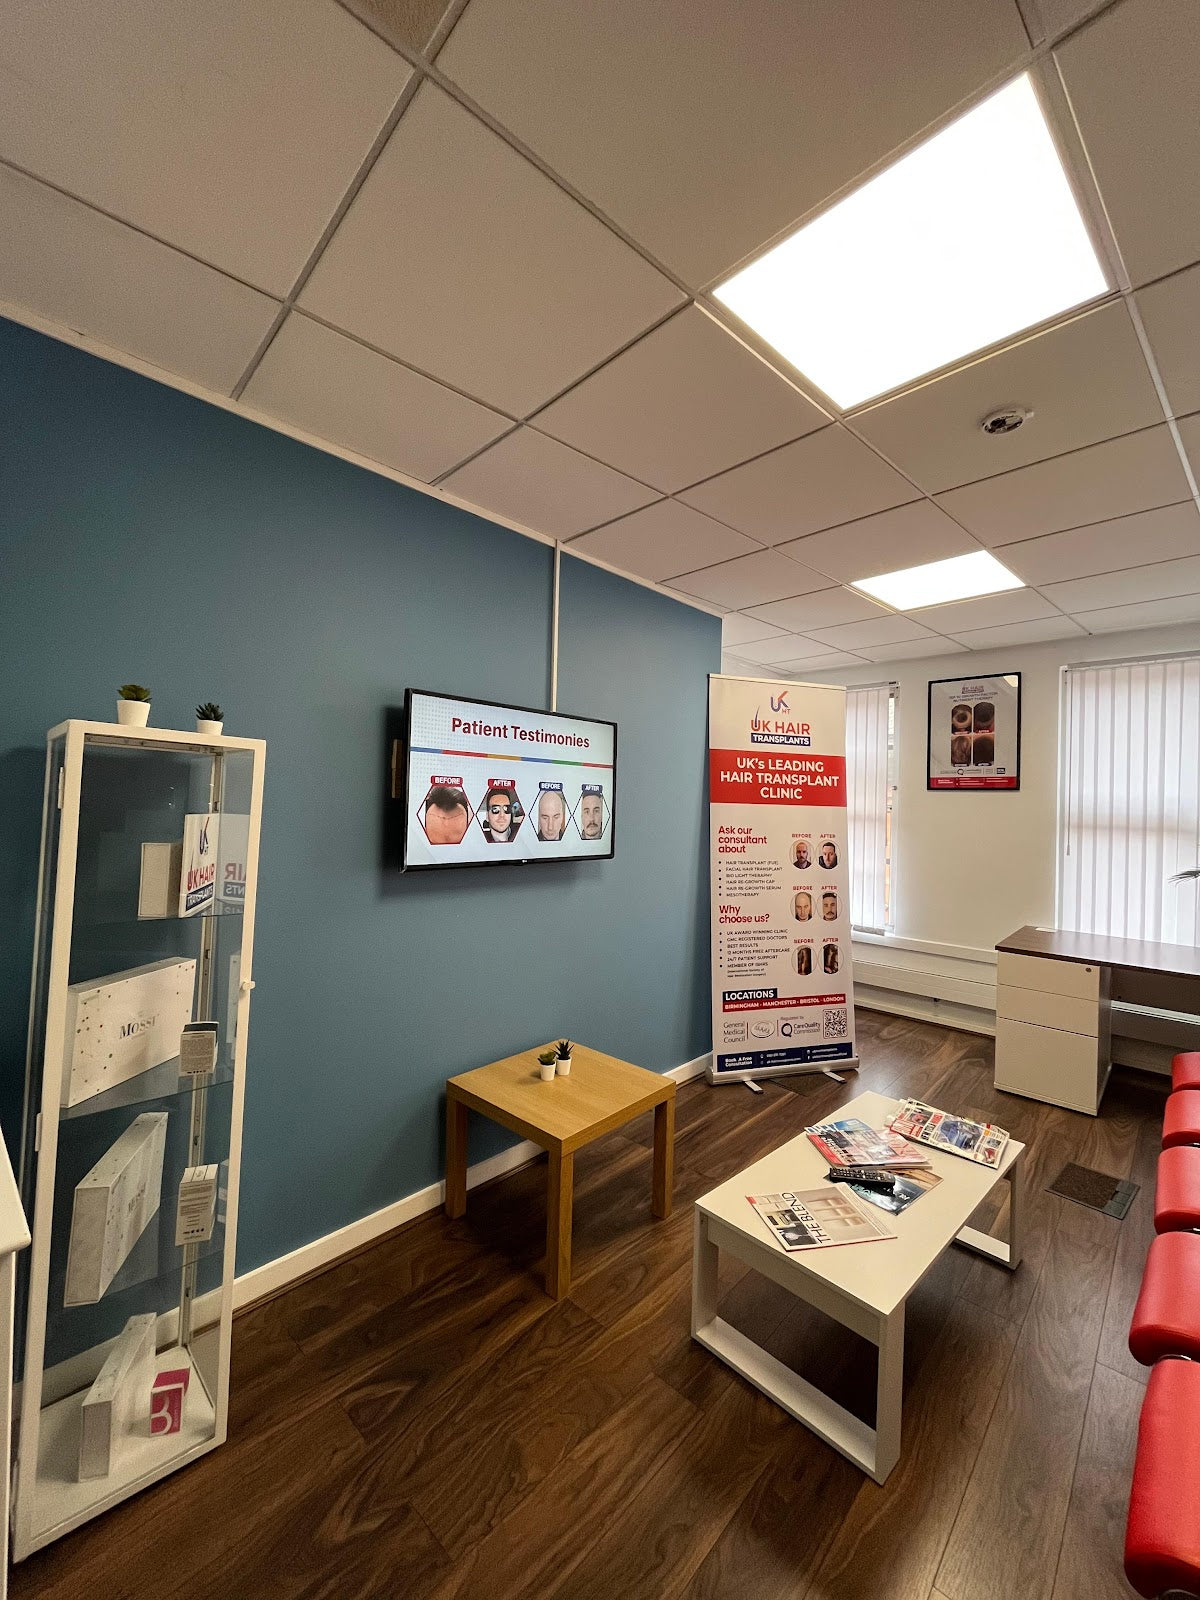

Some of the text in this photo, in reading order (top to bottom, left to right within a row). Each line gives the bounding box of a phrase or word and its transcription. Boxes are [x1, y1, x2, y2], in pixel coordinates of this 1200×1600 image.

[451, 717, 590, 748] Patient Testimonies
[751, 719, 810, 735] UK HAIR
[753, 734, 810, 745] TRANSPLANTS
[736, 757, 824, 772] UK's LEADING
[434, 776, 460, 785] BEFORE
[720, 771, 840, 787] HAIR TRANSPLANT
[760, 787, 802, 799] CLINIC
[718, 826, 753, 835] Ask our
[718, 836, 767, 844] consultant
[718, 845, 746, 854] about
[719, 905, 741, 916] Why
[719, 914, 770, 924] choose us?
[725, 990, 774, 1001] LOCATIONS
[782, 1192, 831, 1243] THE BLEND
